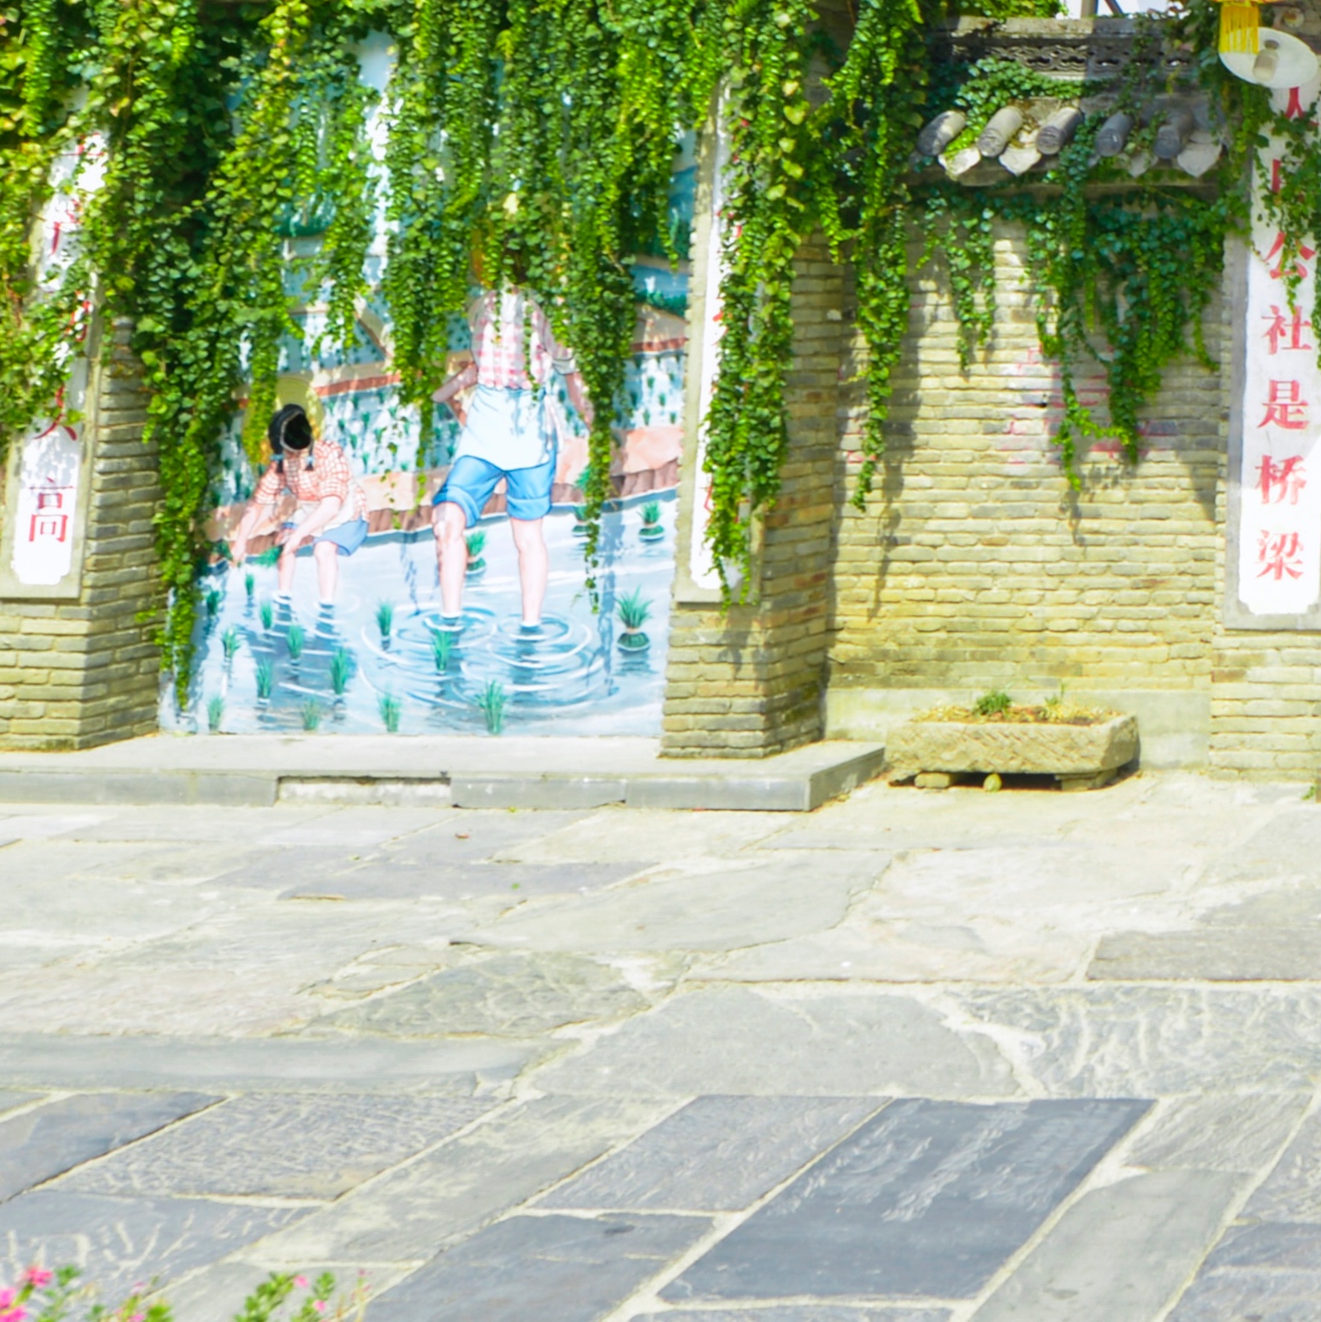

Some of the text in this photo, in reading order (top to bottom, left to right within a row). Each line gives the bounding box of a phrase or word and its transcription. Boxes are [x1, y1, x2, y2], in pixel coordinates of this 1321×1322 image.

[1253, 86, 1319, 580] 人公社是桥梁
